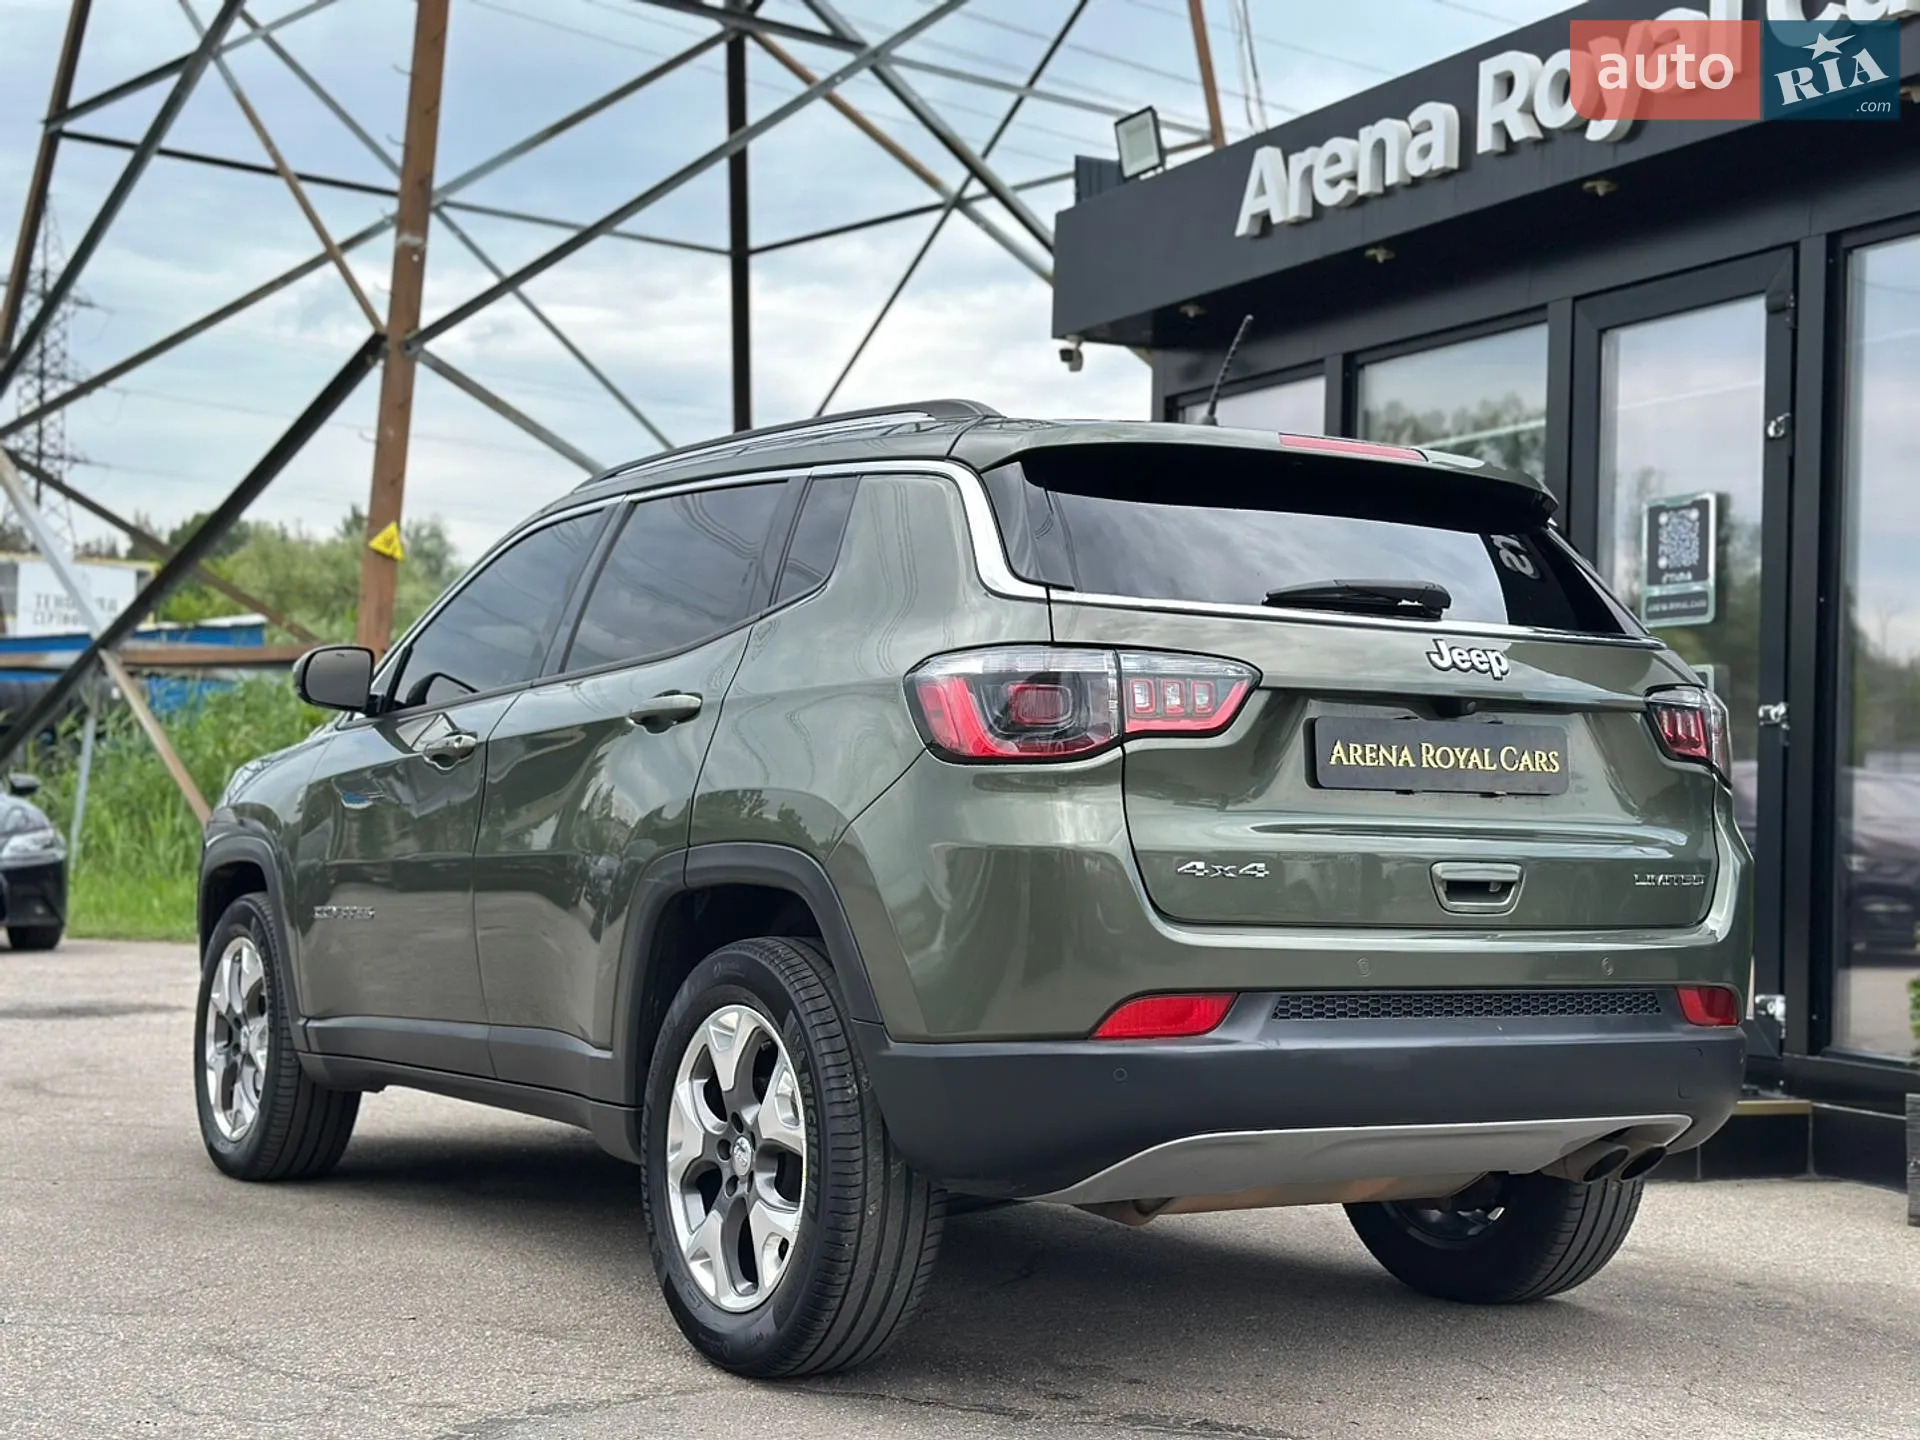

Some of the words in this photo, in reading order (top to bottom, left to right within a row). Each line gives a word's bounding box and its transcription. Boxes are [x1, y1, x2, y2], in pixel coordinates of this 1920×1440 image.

[1235, 100, 1460, 237] Arena
[1426, 639, 1510, 680] Jeep
[1177, 861, 1270, 878] 4x4
